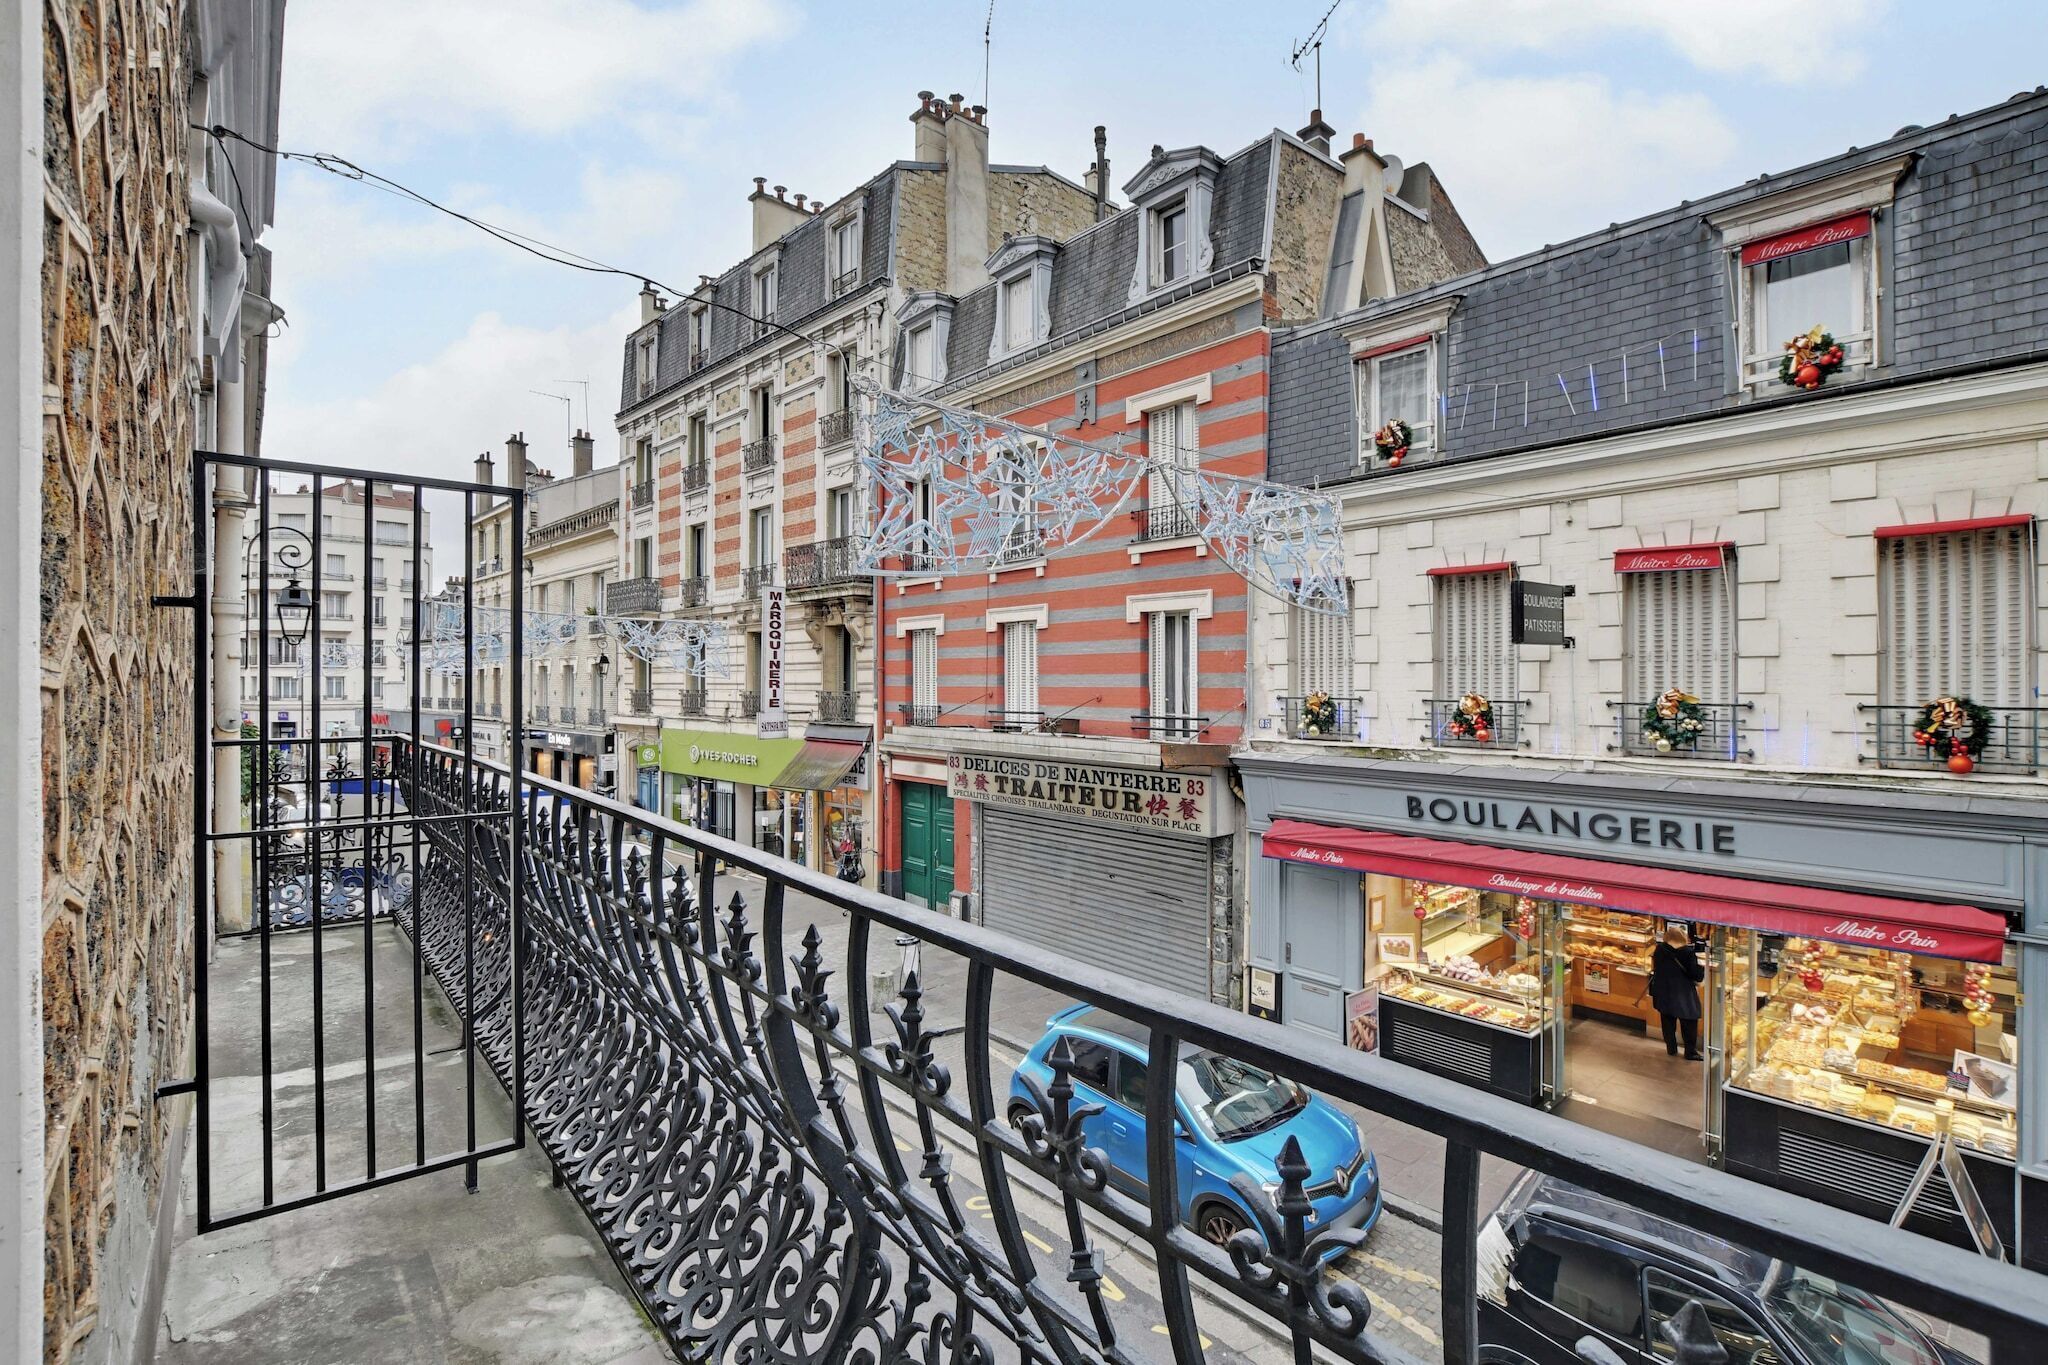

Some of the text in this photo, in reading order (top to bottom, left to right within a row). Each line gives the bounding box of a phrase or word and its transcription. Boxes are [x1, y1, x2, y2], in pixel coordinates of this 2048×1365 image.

[1811, 226, 1857, 246] Pain
[1672, 553, 1710, 568] Pain
[1523, 593, 1563, 610] BOULANGERIE
[1523, 618, 1563, 633] PATISSERIE
[769, 591, 782, 708] MAROQUINERIE
[699, 749, 758, 766] YVES ROCHER
[949, 756, 1204, 796] 83 DELICES DE NANTERRE 83
[994, 775, 1143, 814] TRAITEUR
[953, 788, 1202, 832] SPECIALITES CHINOISES THAILANDAISES DEGUSTATION SUR PLACE
[1406, 794, 1736, 855] BOULANGERIE
[1321, 850, 1344, 864] Pain
[1488, 873, 1604, 900] Boulanger de tradition
[1824, 921, 1938, 949] Maître Pain
